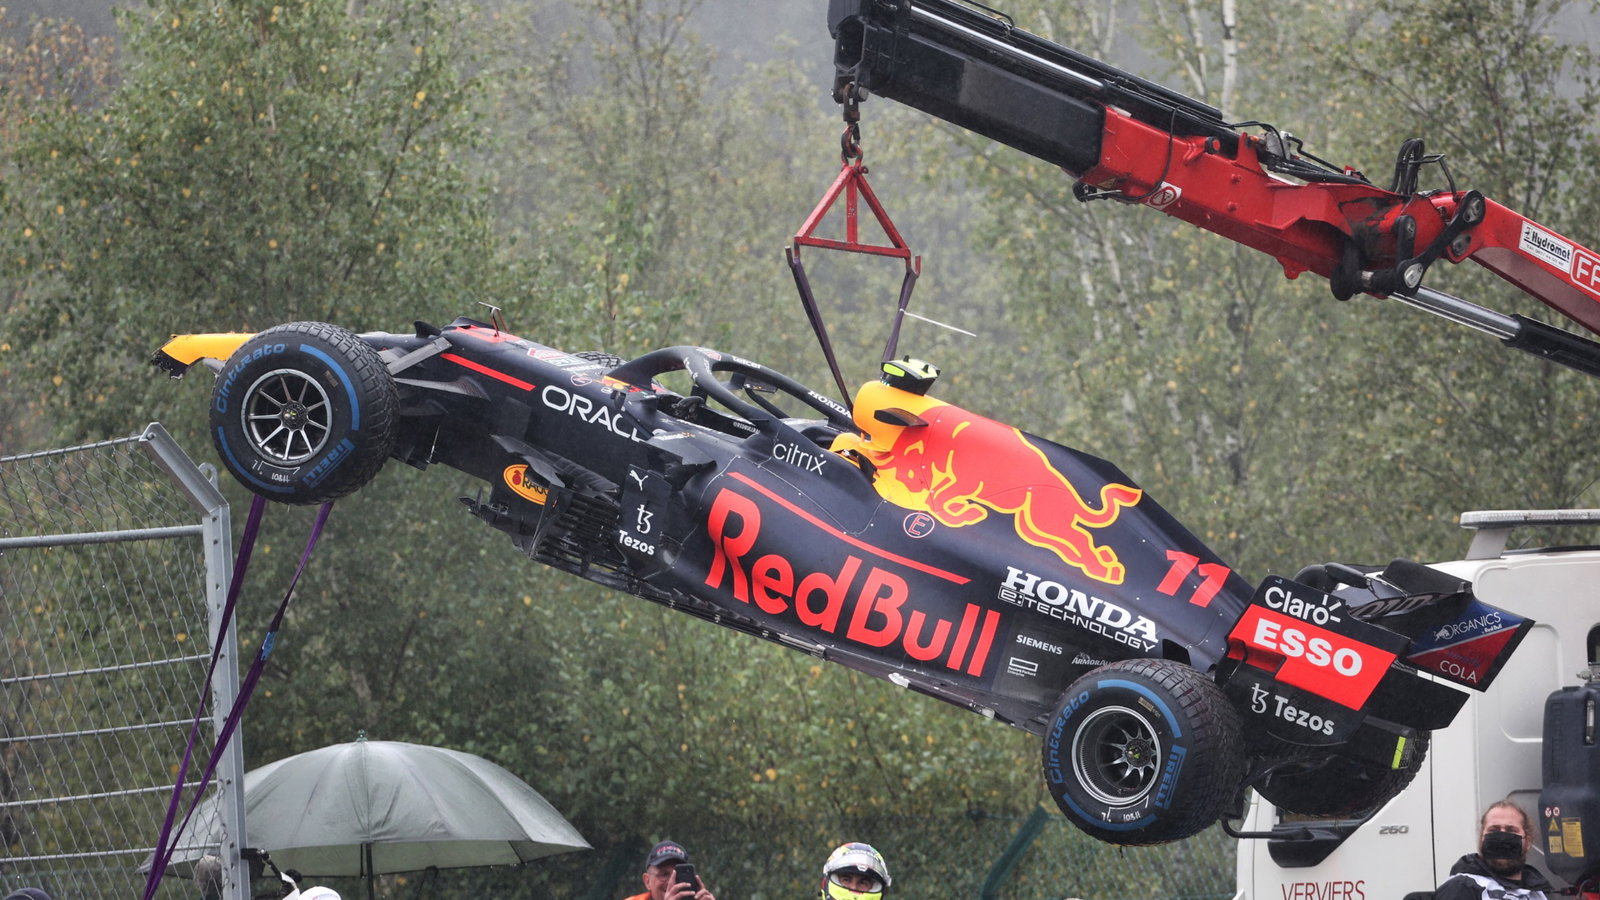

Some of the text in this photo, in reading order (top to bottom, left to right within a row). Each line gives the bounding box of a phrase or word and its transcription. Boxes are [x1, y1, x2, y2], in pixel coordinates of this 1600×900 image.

[1531, 231, 1570, 260] Hydromat
[808, 390, 852, 419] HONDA
[302, 437, 355, 488] PIRELLI
[772, 439, 827, 475] citrix
[618, 529, 655, 555] Tezos
[1155, 549, 1231, 608] 11
[1001, 566, 1159, 644] HONDA
[1264, 586, 1330, 626] Claro
[1442, 611, 1501, 640] ORGANICS
[1015, 634, 1063, 655] SIEMENS
[1253, 617, 1363, 677] ESSO
[1439, 660, 1477, 683] COLA
[1274, 695, 1335, 737] Tezos
[1154, 744, 1187, 811] PIRELLI
[1379, 825, 1410, 835] 260
[1281, 880, 1366, 900] VERVIERS
